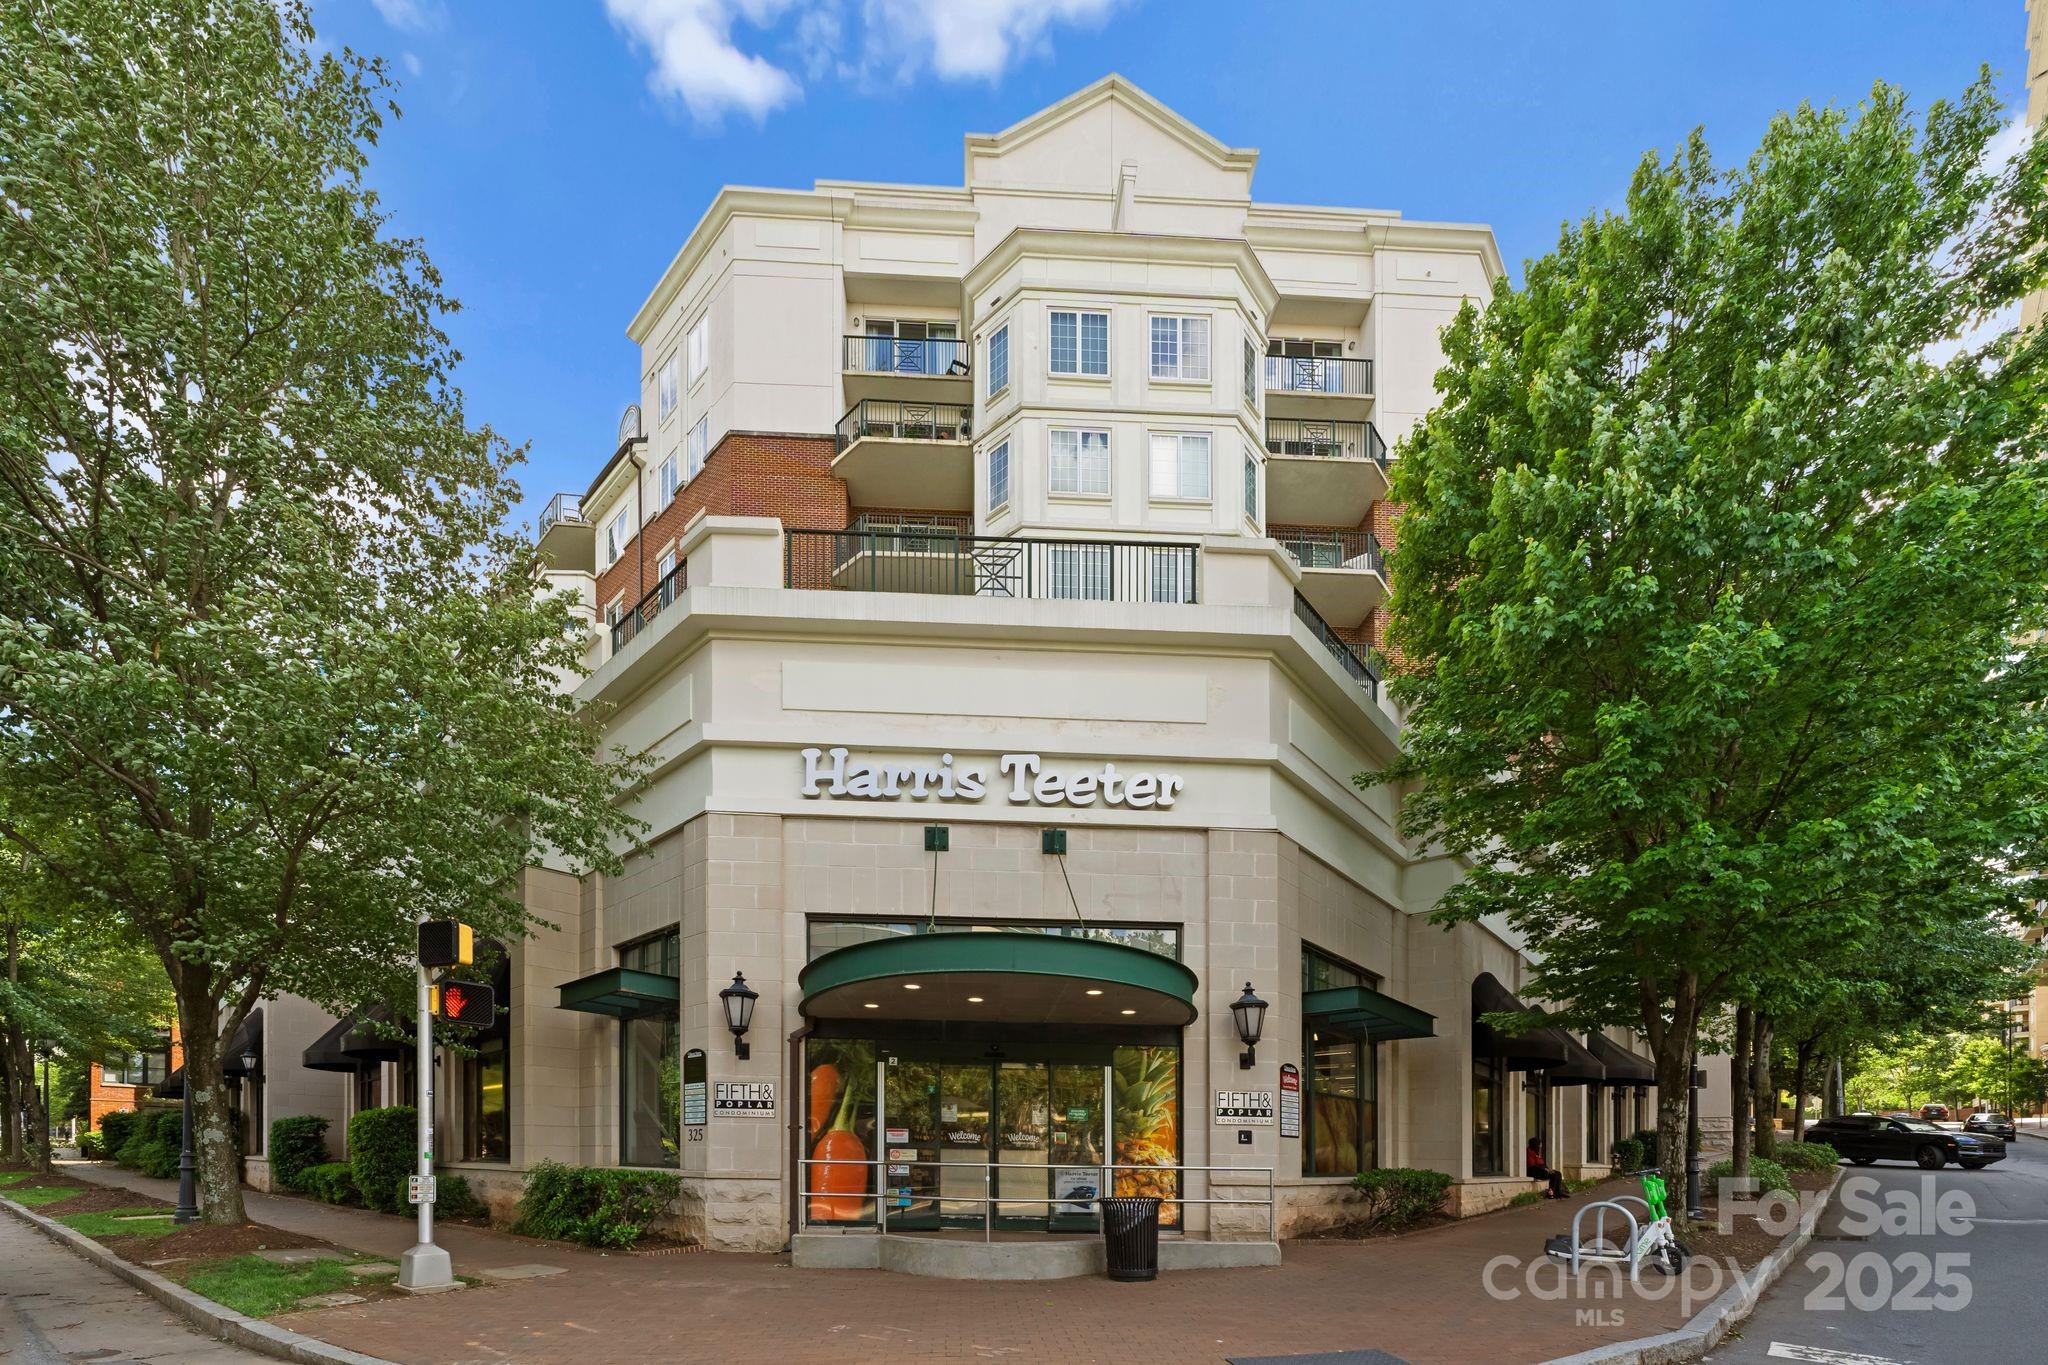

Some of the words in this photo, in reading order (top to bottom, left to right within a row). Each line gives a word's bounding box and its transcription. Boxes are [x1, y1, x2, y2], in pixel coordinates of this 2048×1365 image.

[801, 747, 987, 801] Harris
[999, 753, 1184, 810] Teeter
[688, 1128, 703, 1142] 325
[948, 1130, 982, 1142] Welcome
[1007, 1131, 1040, 1143] Welcome
